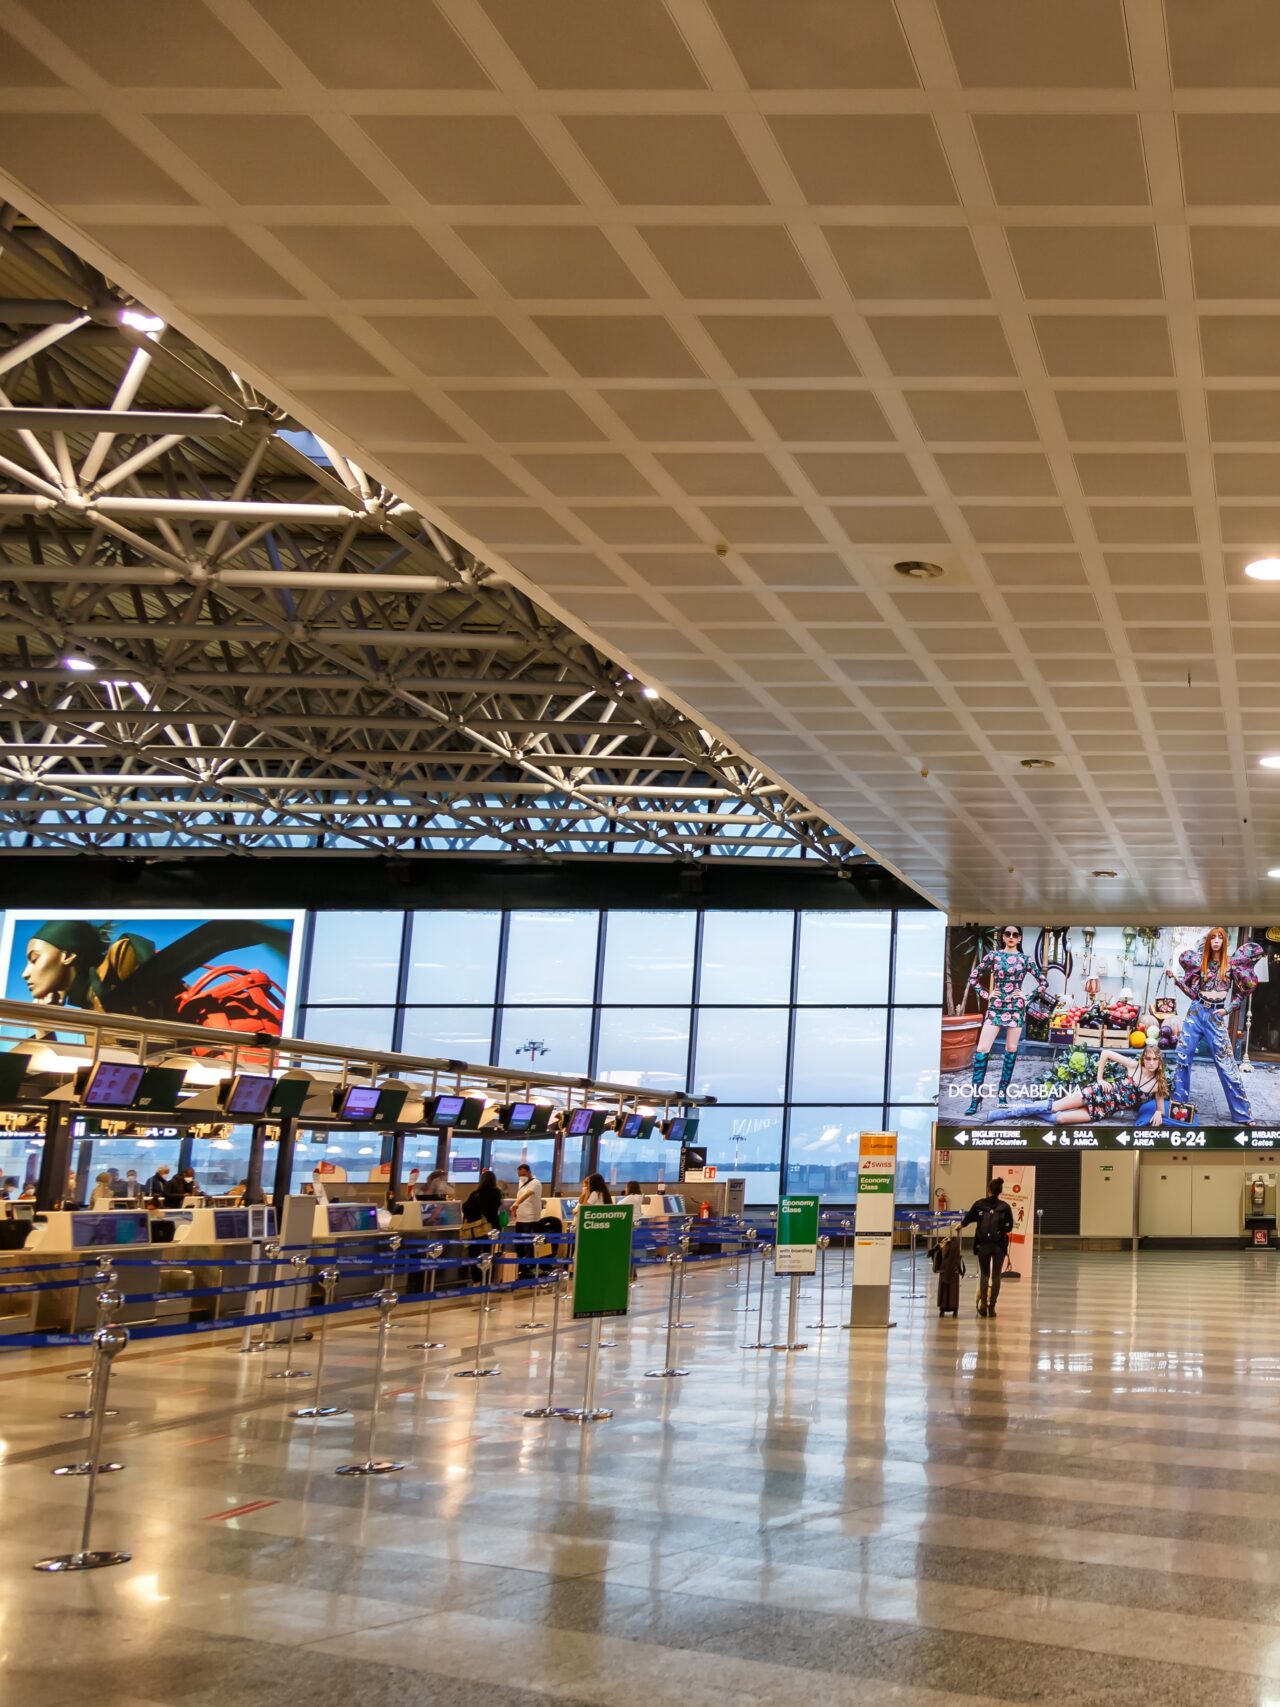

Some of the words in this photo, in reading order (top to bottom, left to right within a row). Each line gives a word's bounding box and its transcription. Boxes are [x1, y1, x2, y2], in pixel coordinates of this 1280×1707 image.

[949, 1084, 997, 1098] DOLCE
[998, 1090, 1005, 1098] &
[1006, 1083, 1083, 1098] GABBANA
[971, 1130, 1021, 1138] BIGLIETTERIE
[1073, 1130, 1094, 1138] SALA
[1133, 1131, 1170, 1139] CHECK-IN
[971, 1138, 994, 1146] Ticket
[994, 1138, 1028, 1146] Counters
[1073, 1138, 1099, 1146] AMICA
[1170, 1131, 1206, 1147] 6-24
[1252, 1139, 1274, 1147] Gates
[782, 1199, 814, 1207] Economy
[584, 1211, 627, 1220] Economy
[583, 1221, 611, 1229] Class
